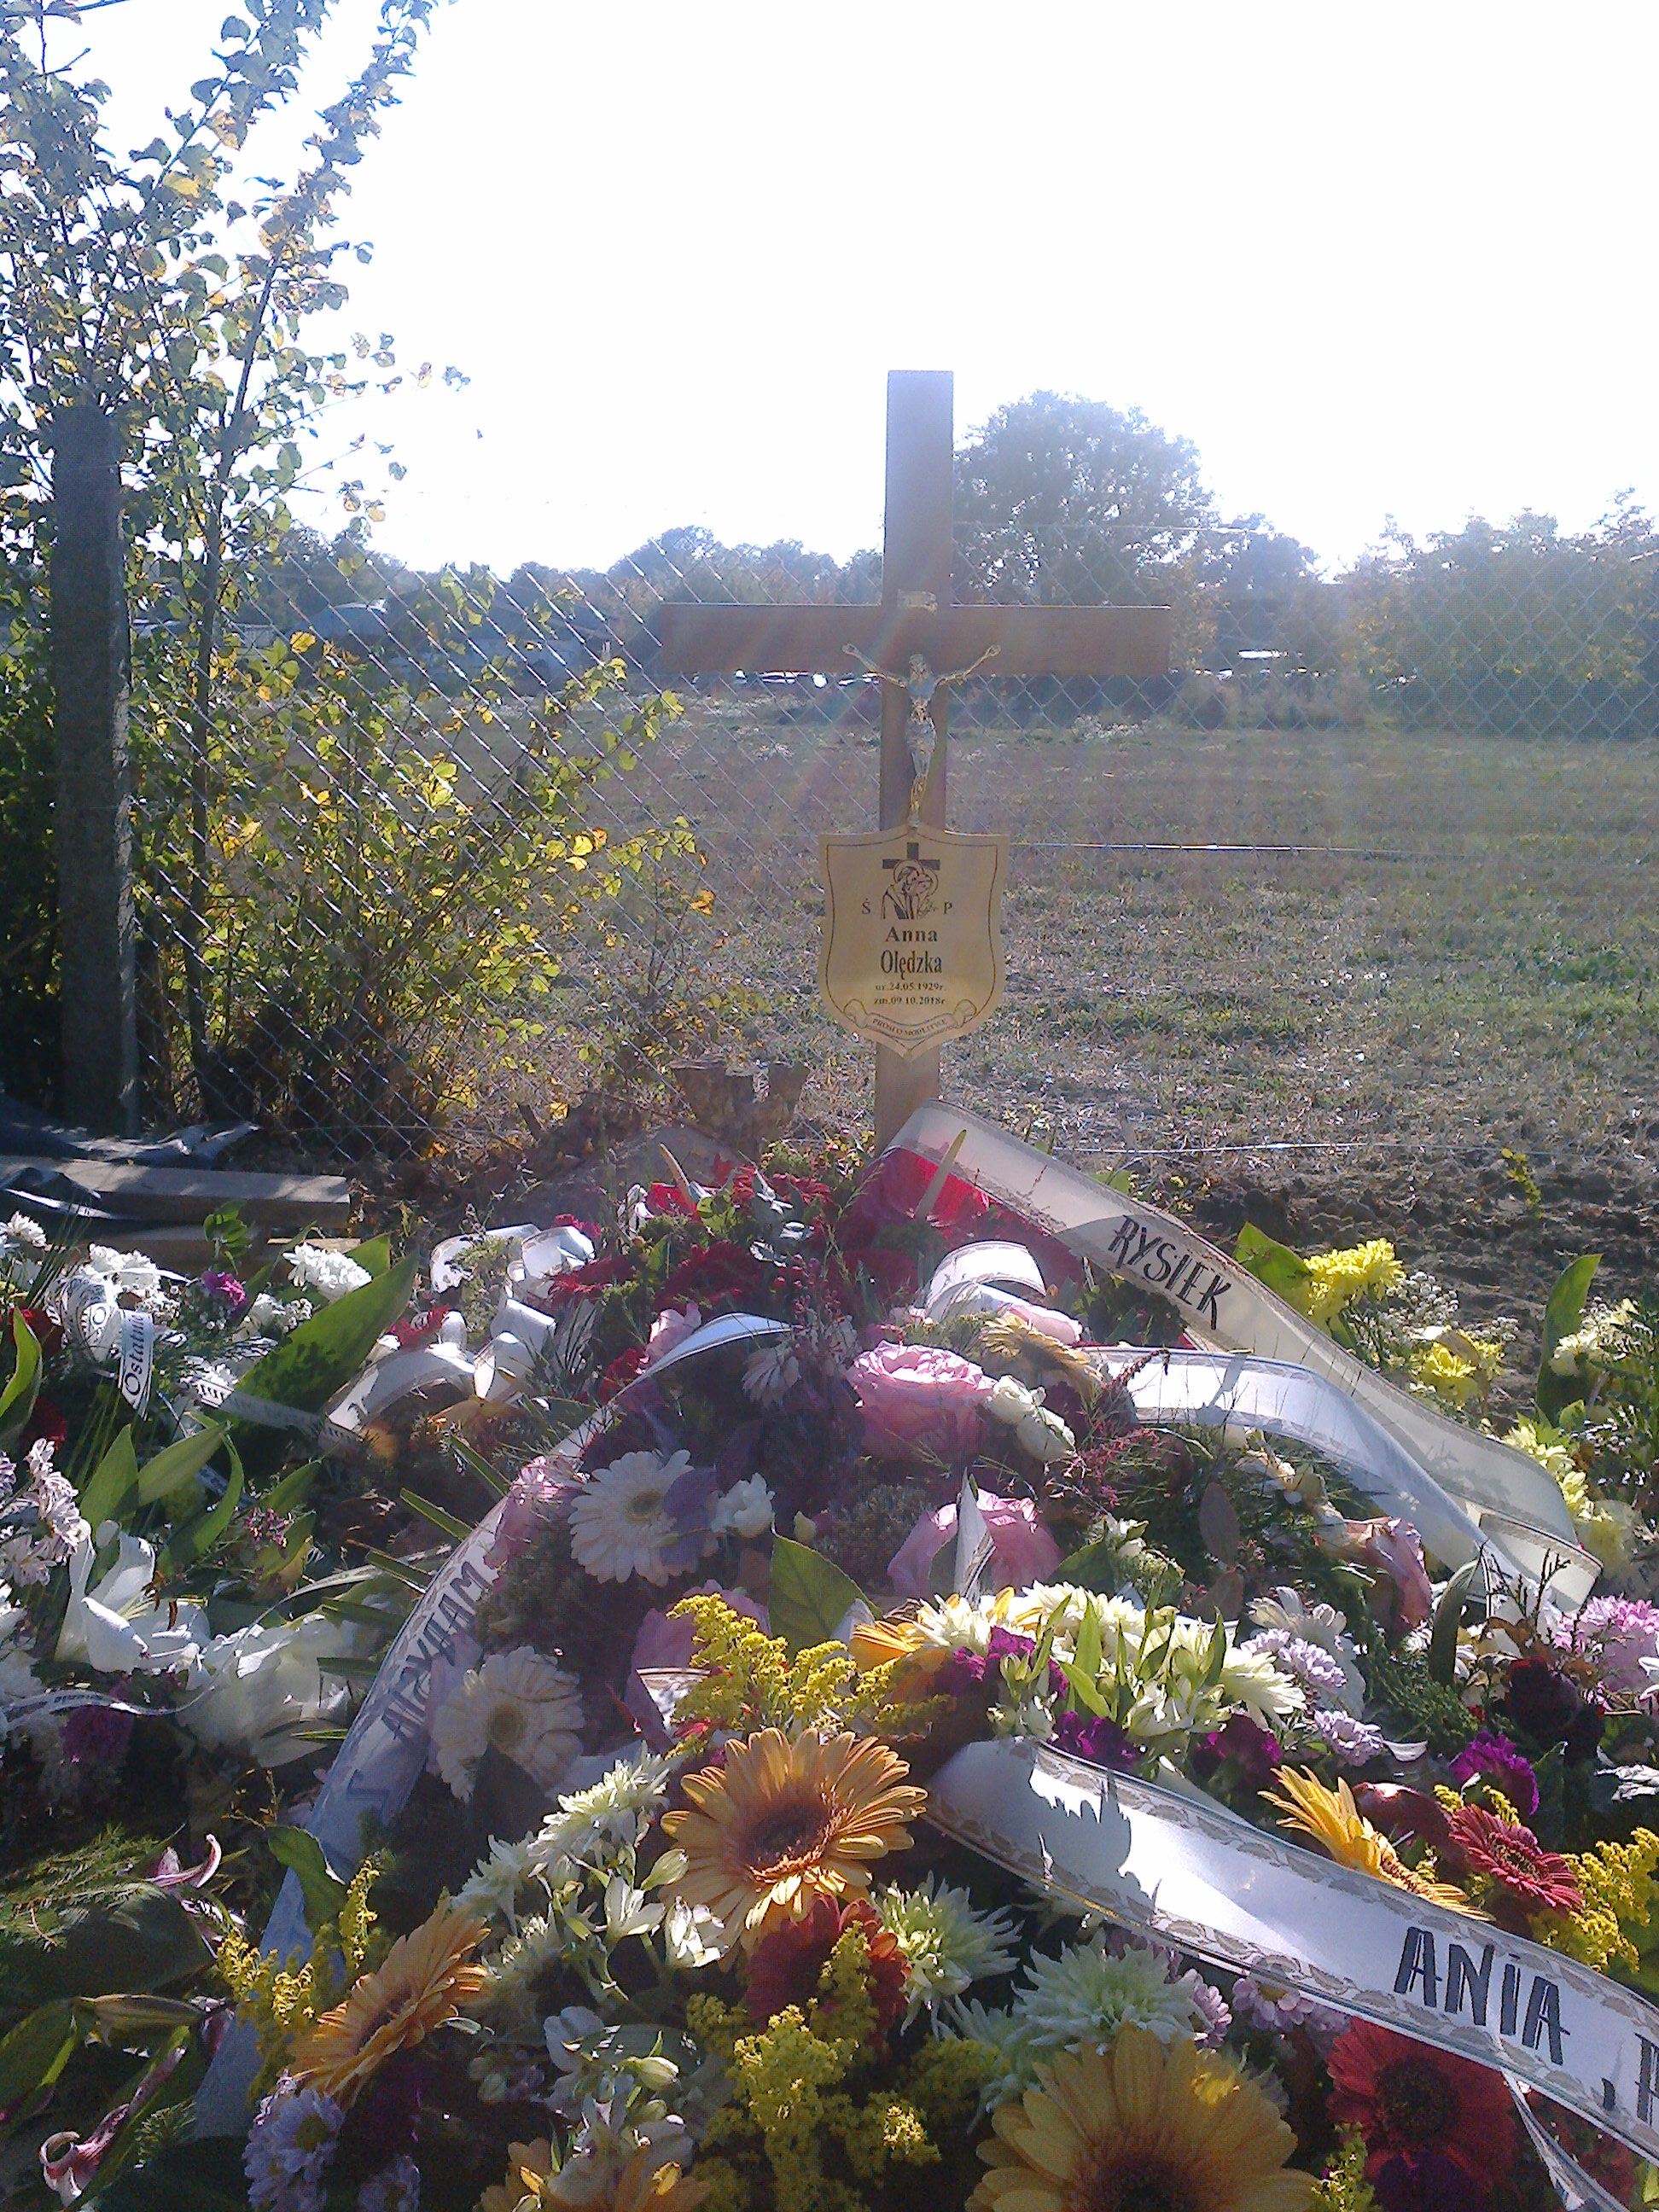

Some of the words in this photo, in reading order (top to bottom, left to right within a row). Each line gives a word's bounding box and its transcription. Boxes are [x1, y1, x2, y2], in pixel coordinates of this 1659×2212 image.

[861, 897, 871, 916] Ś
[943, 901, 953, 915] P
[885, 926, 938, 942] Anna
[880, 949, 943, 981] Olędzka
[1108, 1214, 1231, 1330] RYSIEK
[1393, 1925, 1571, 2067] ANIA
